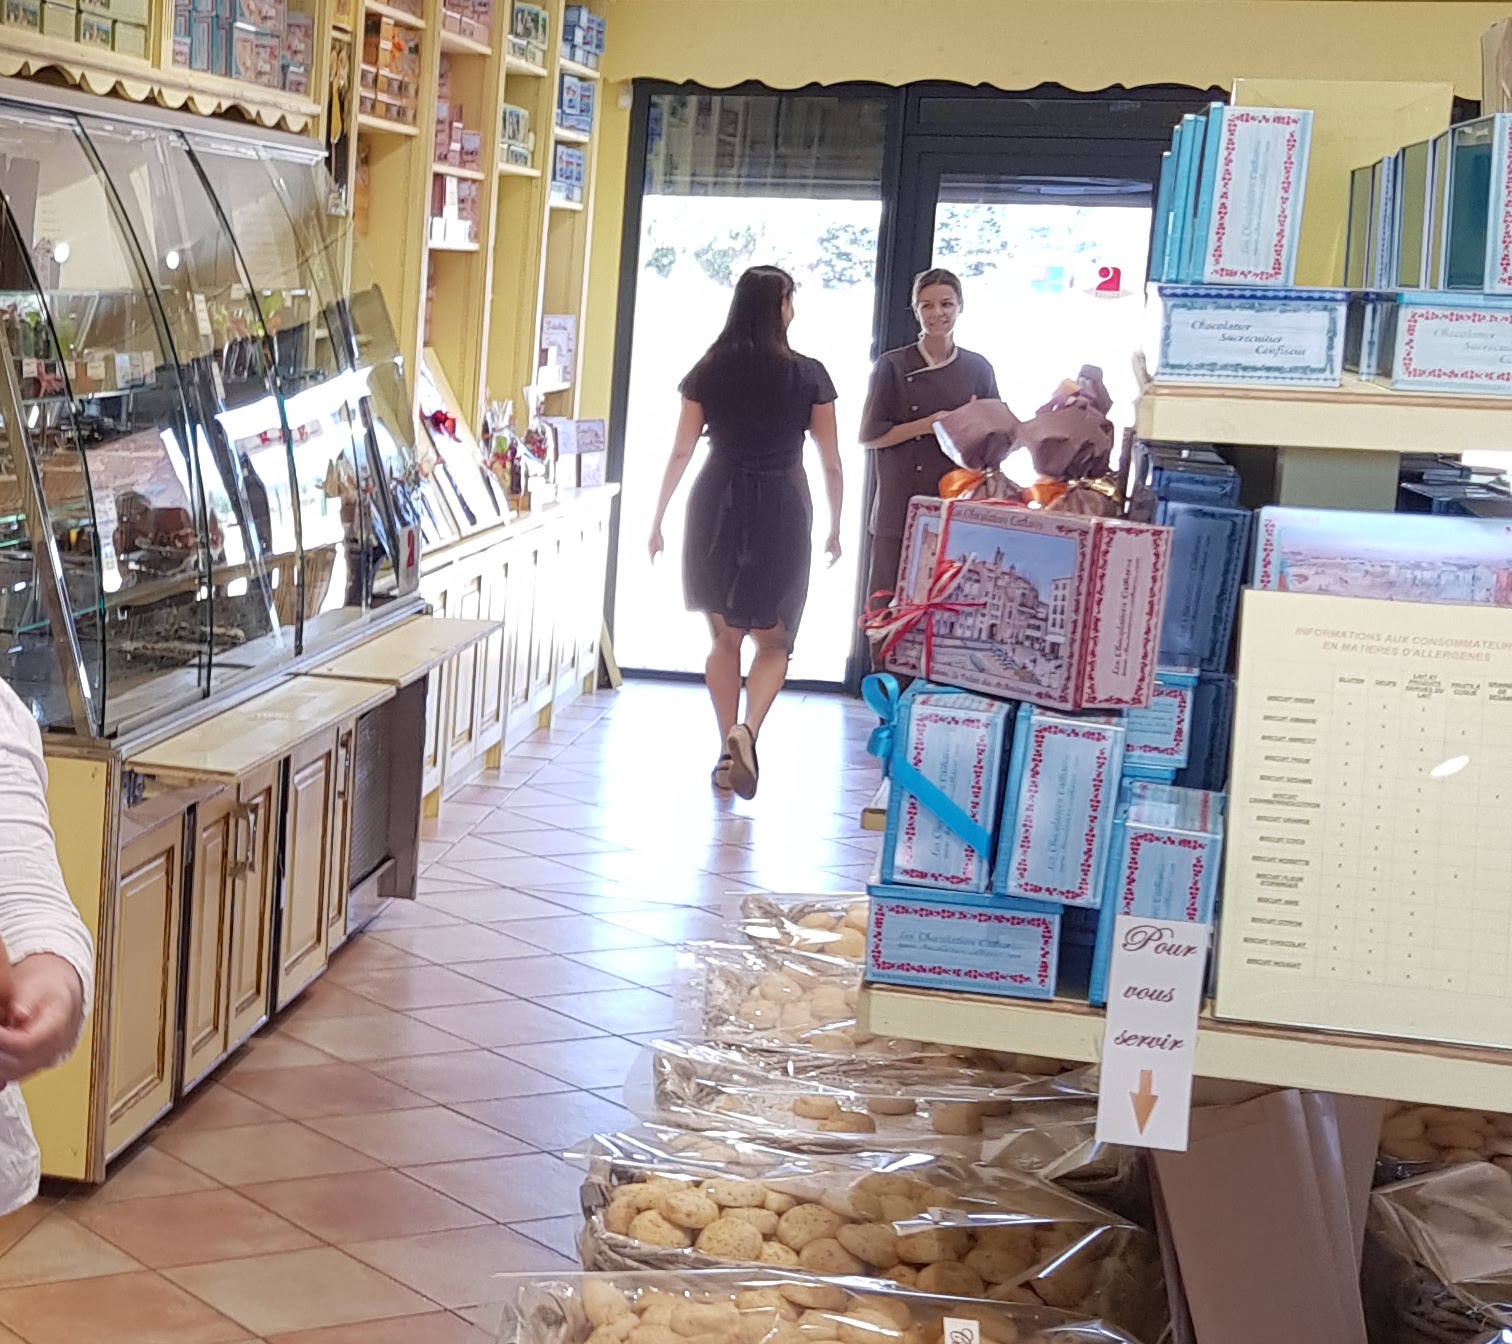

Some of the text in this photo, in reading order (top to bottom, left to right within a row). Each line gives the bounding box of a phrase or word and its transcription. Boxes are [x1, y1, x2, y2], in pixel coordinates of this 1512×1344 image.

[1322, 641, 1339, 652] EN
[1384, 633, 1410, 646] AUX
[1122, 925, 1198, 957] Pour
[1123, 985, 1176, 1003] vous
[1114, 1029, 1184, 1051] servir
